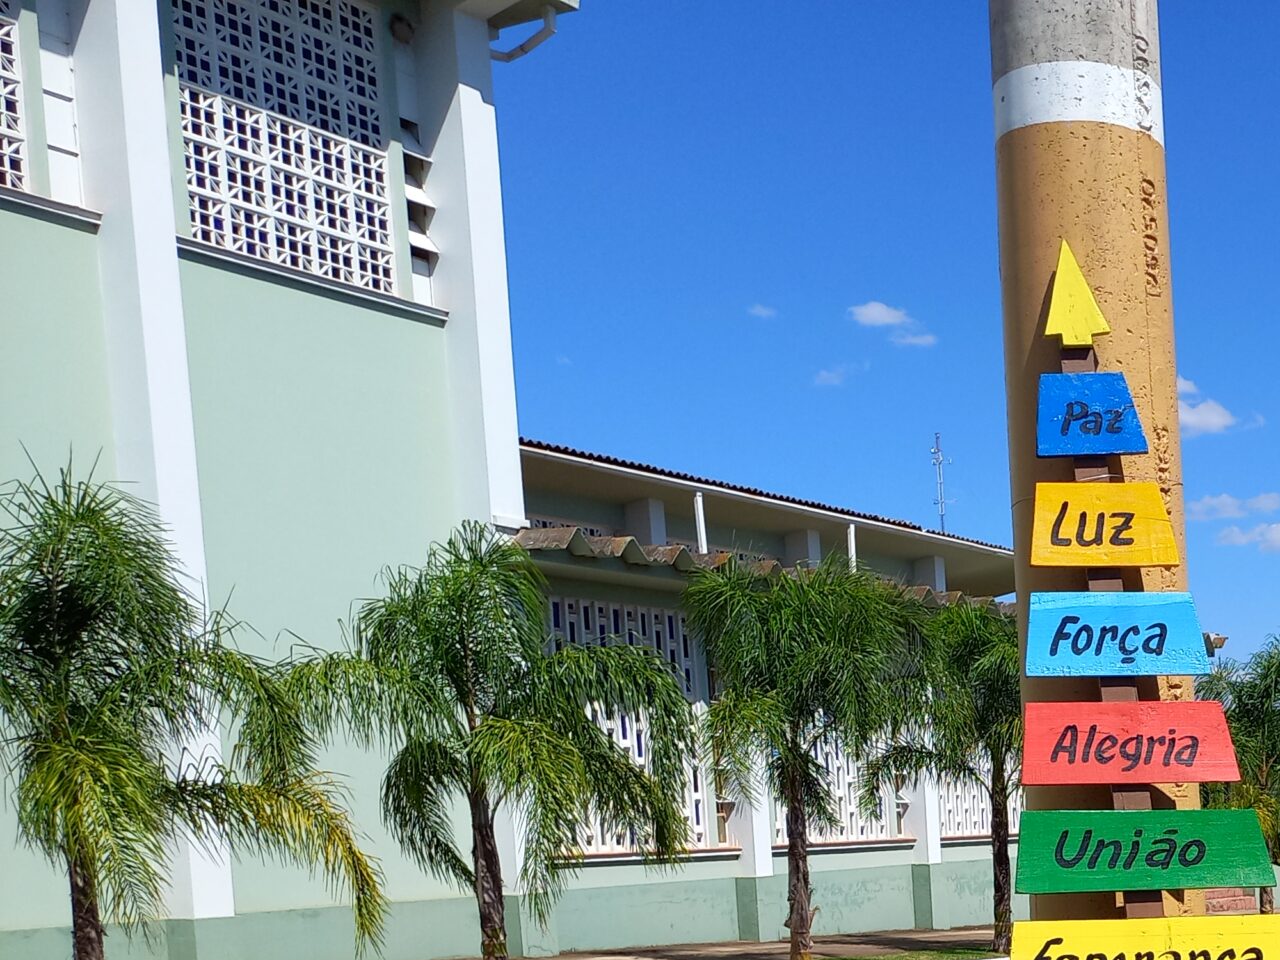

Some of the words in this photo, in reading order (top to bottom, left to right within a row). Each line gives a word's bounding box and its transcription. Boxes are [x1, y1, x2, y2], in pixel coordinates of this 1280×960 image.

[1060, 401, 1124, 436] Paz
[1050, 501, 1135, 547] Luz
[1049, 615, 1168, 664] Força
[1050, 724, 1199, 772] Alegria
[1054, 829, 1207, 870] União
